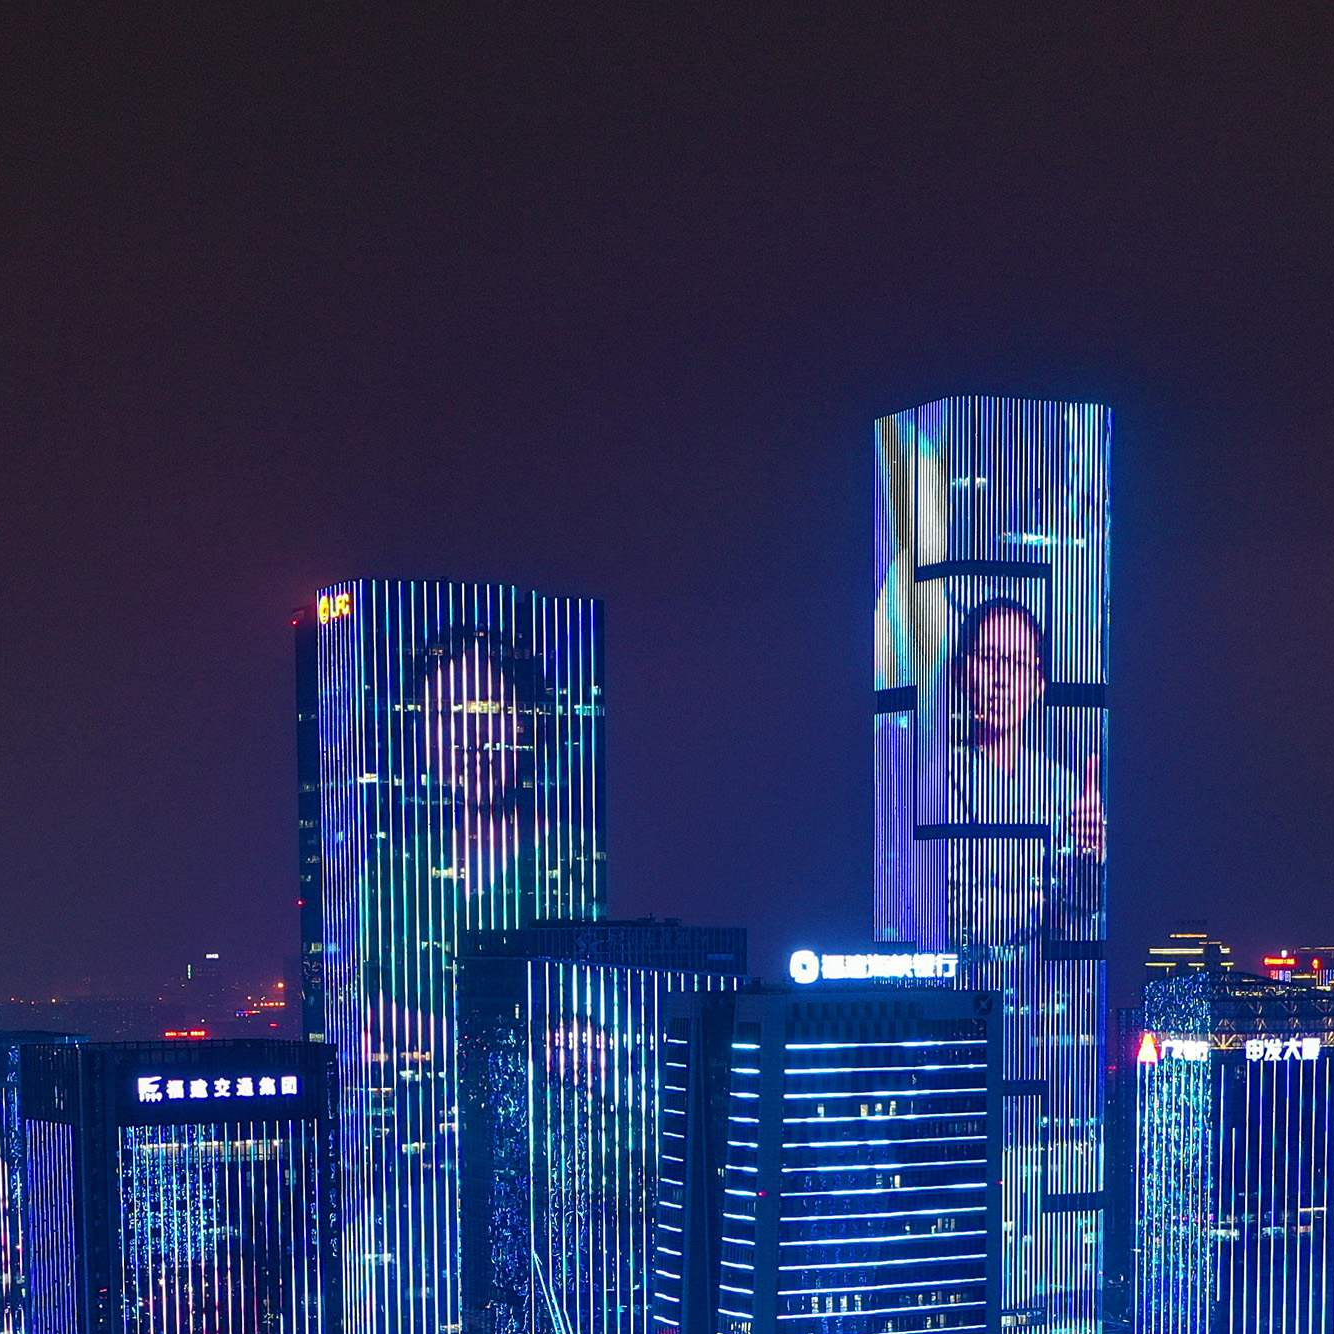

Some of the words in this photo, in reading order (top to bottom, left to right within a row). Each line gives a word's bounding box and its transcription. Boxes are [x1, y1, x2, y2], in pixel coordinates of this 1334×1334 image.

[166, 1076, 298, 1099] 福建交通集团
